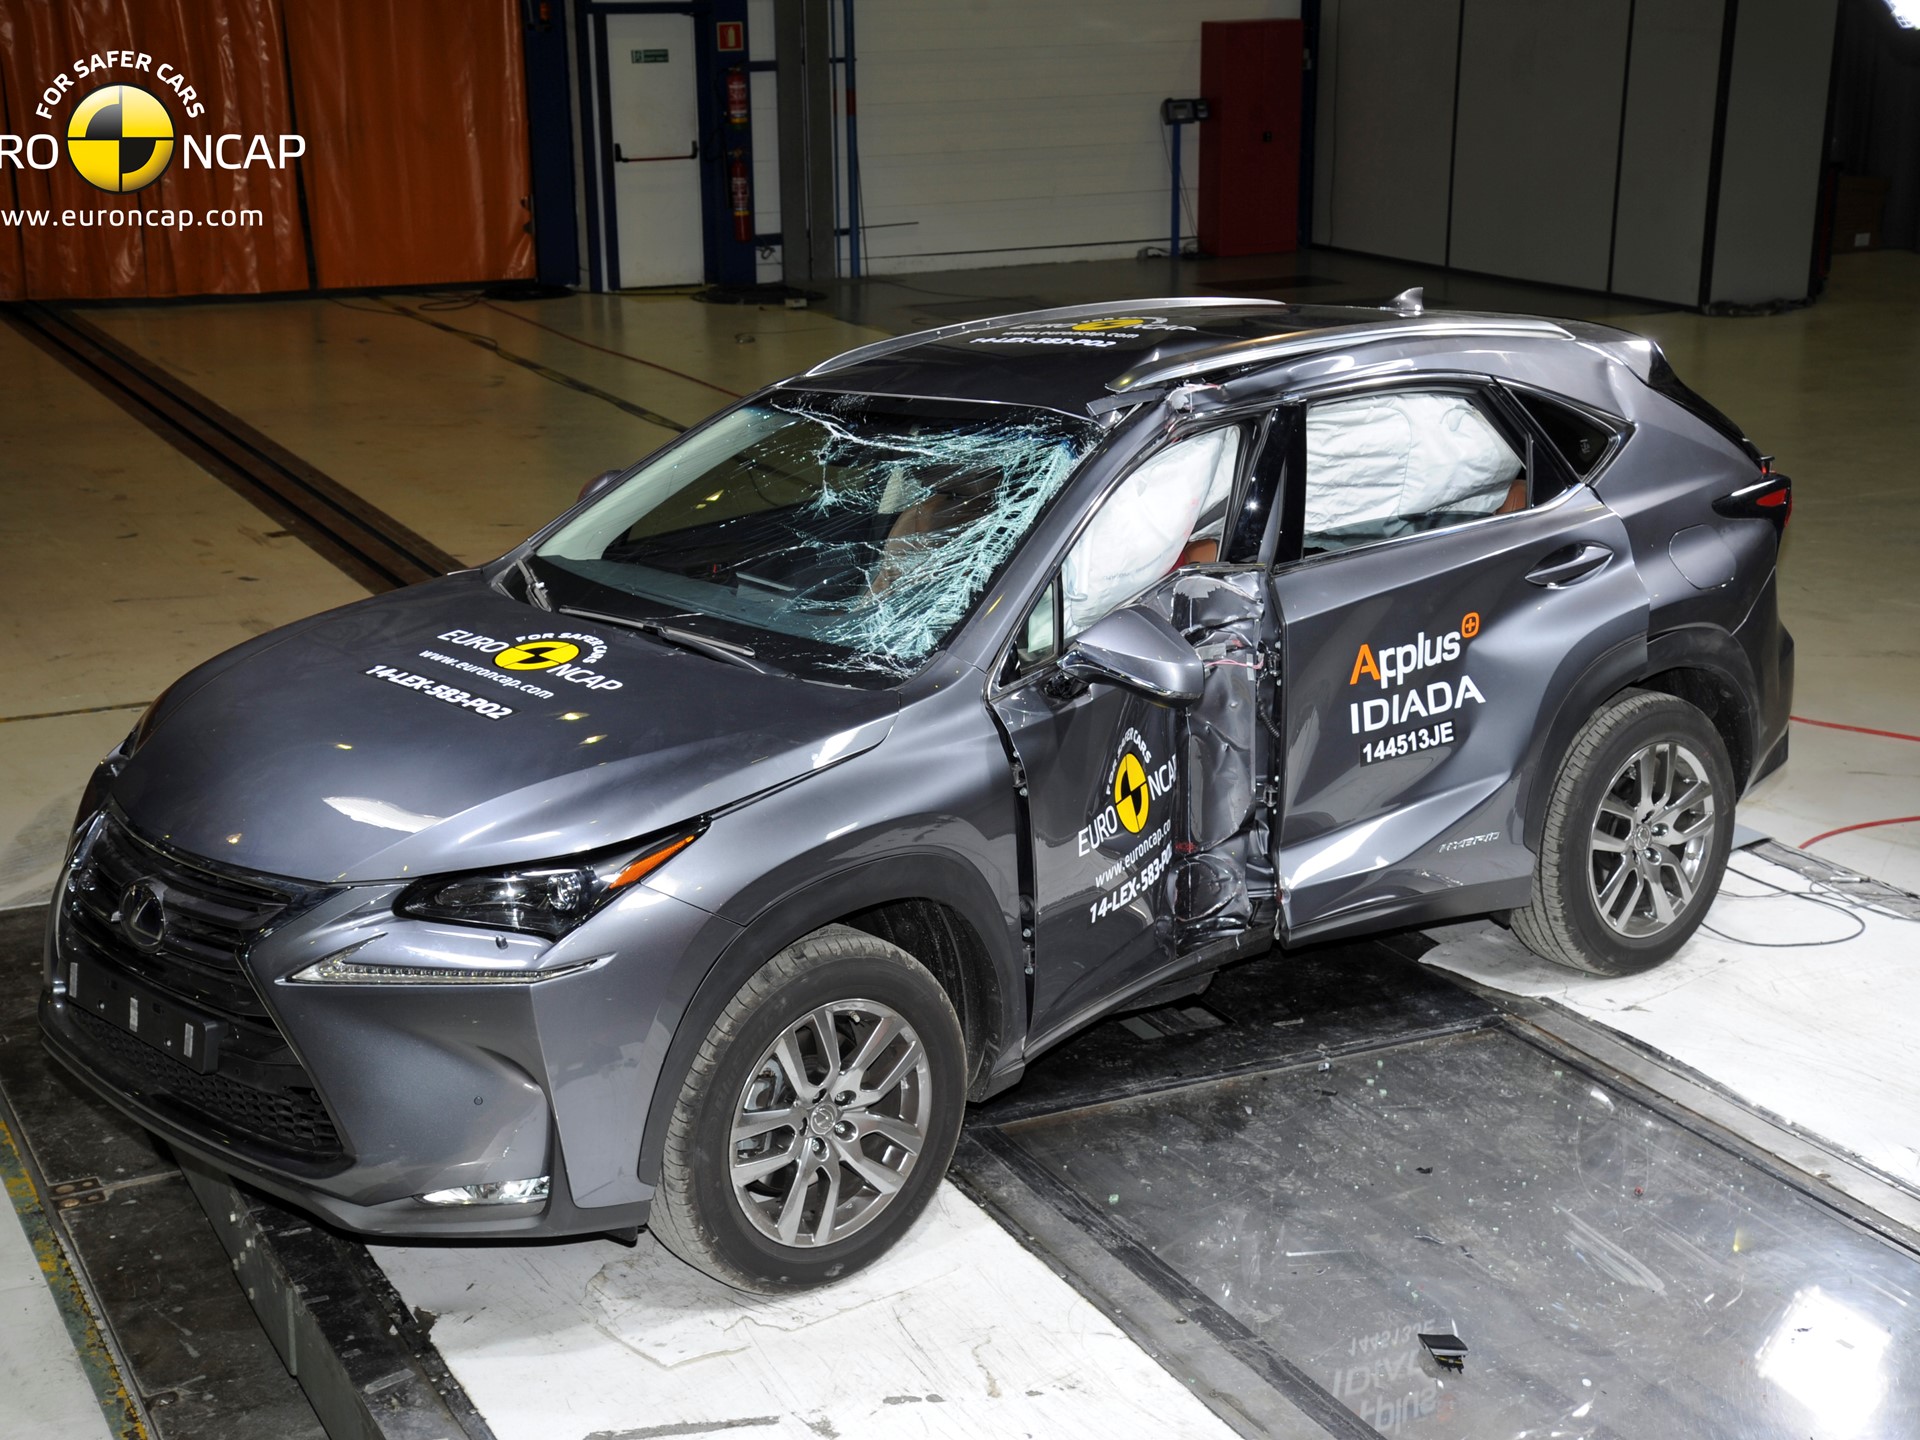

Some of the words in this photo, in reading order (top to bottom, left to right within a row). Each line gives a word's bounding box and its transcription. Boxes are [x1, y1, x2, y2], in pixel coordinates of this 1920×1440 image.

[437, 629, 510, 654] EURO
[546, 663, 623, 691] NCAP
[515, 632, 555, 643] FOR
[557, 632, 604, 647] SAFER
[419, 649, 555, 700] www.euroncap.com
[1350, 675, 1487, 734] IDIADA
[1133, 729, 1152, 764] CARS
[1362, 721, 1455, 763] 144513JE
[1078, 804, 1118, 858] EURO
[1147, 753, 1177, 801] NCA
[1090, 840, 1173, 924] 14-LEX-583-P0
[1095, 819, 1171, 888] www.euroncap.co
